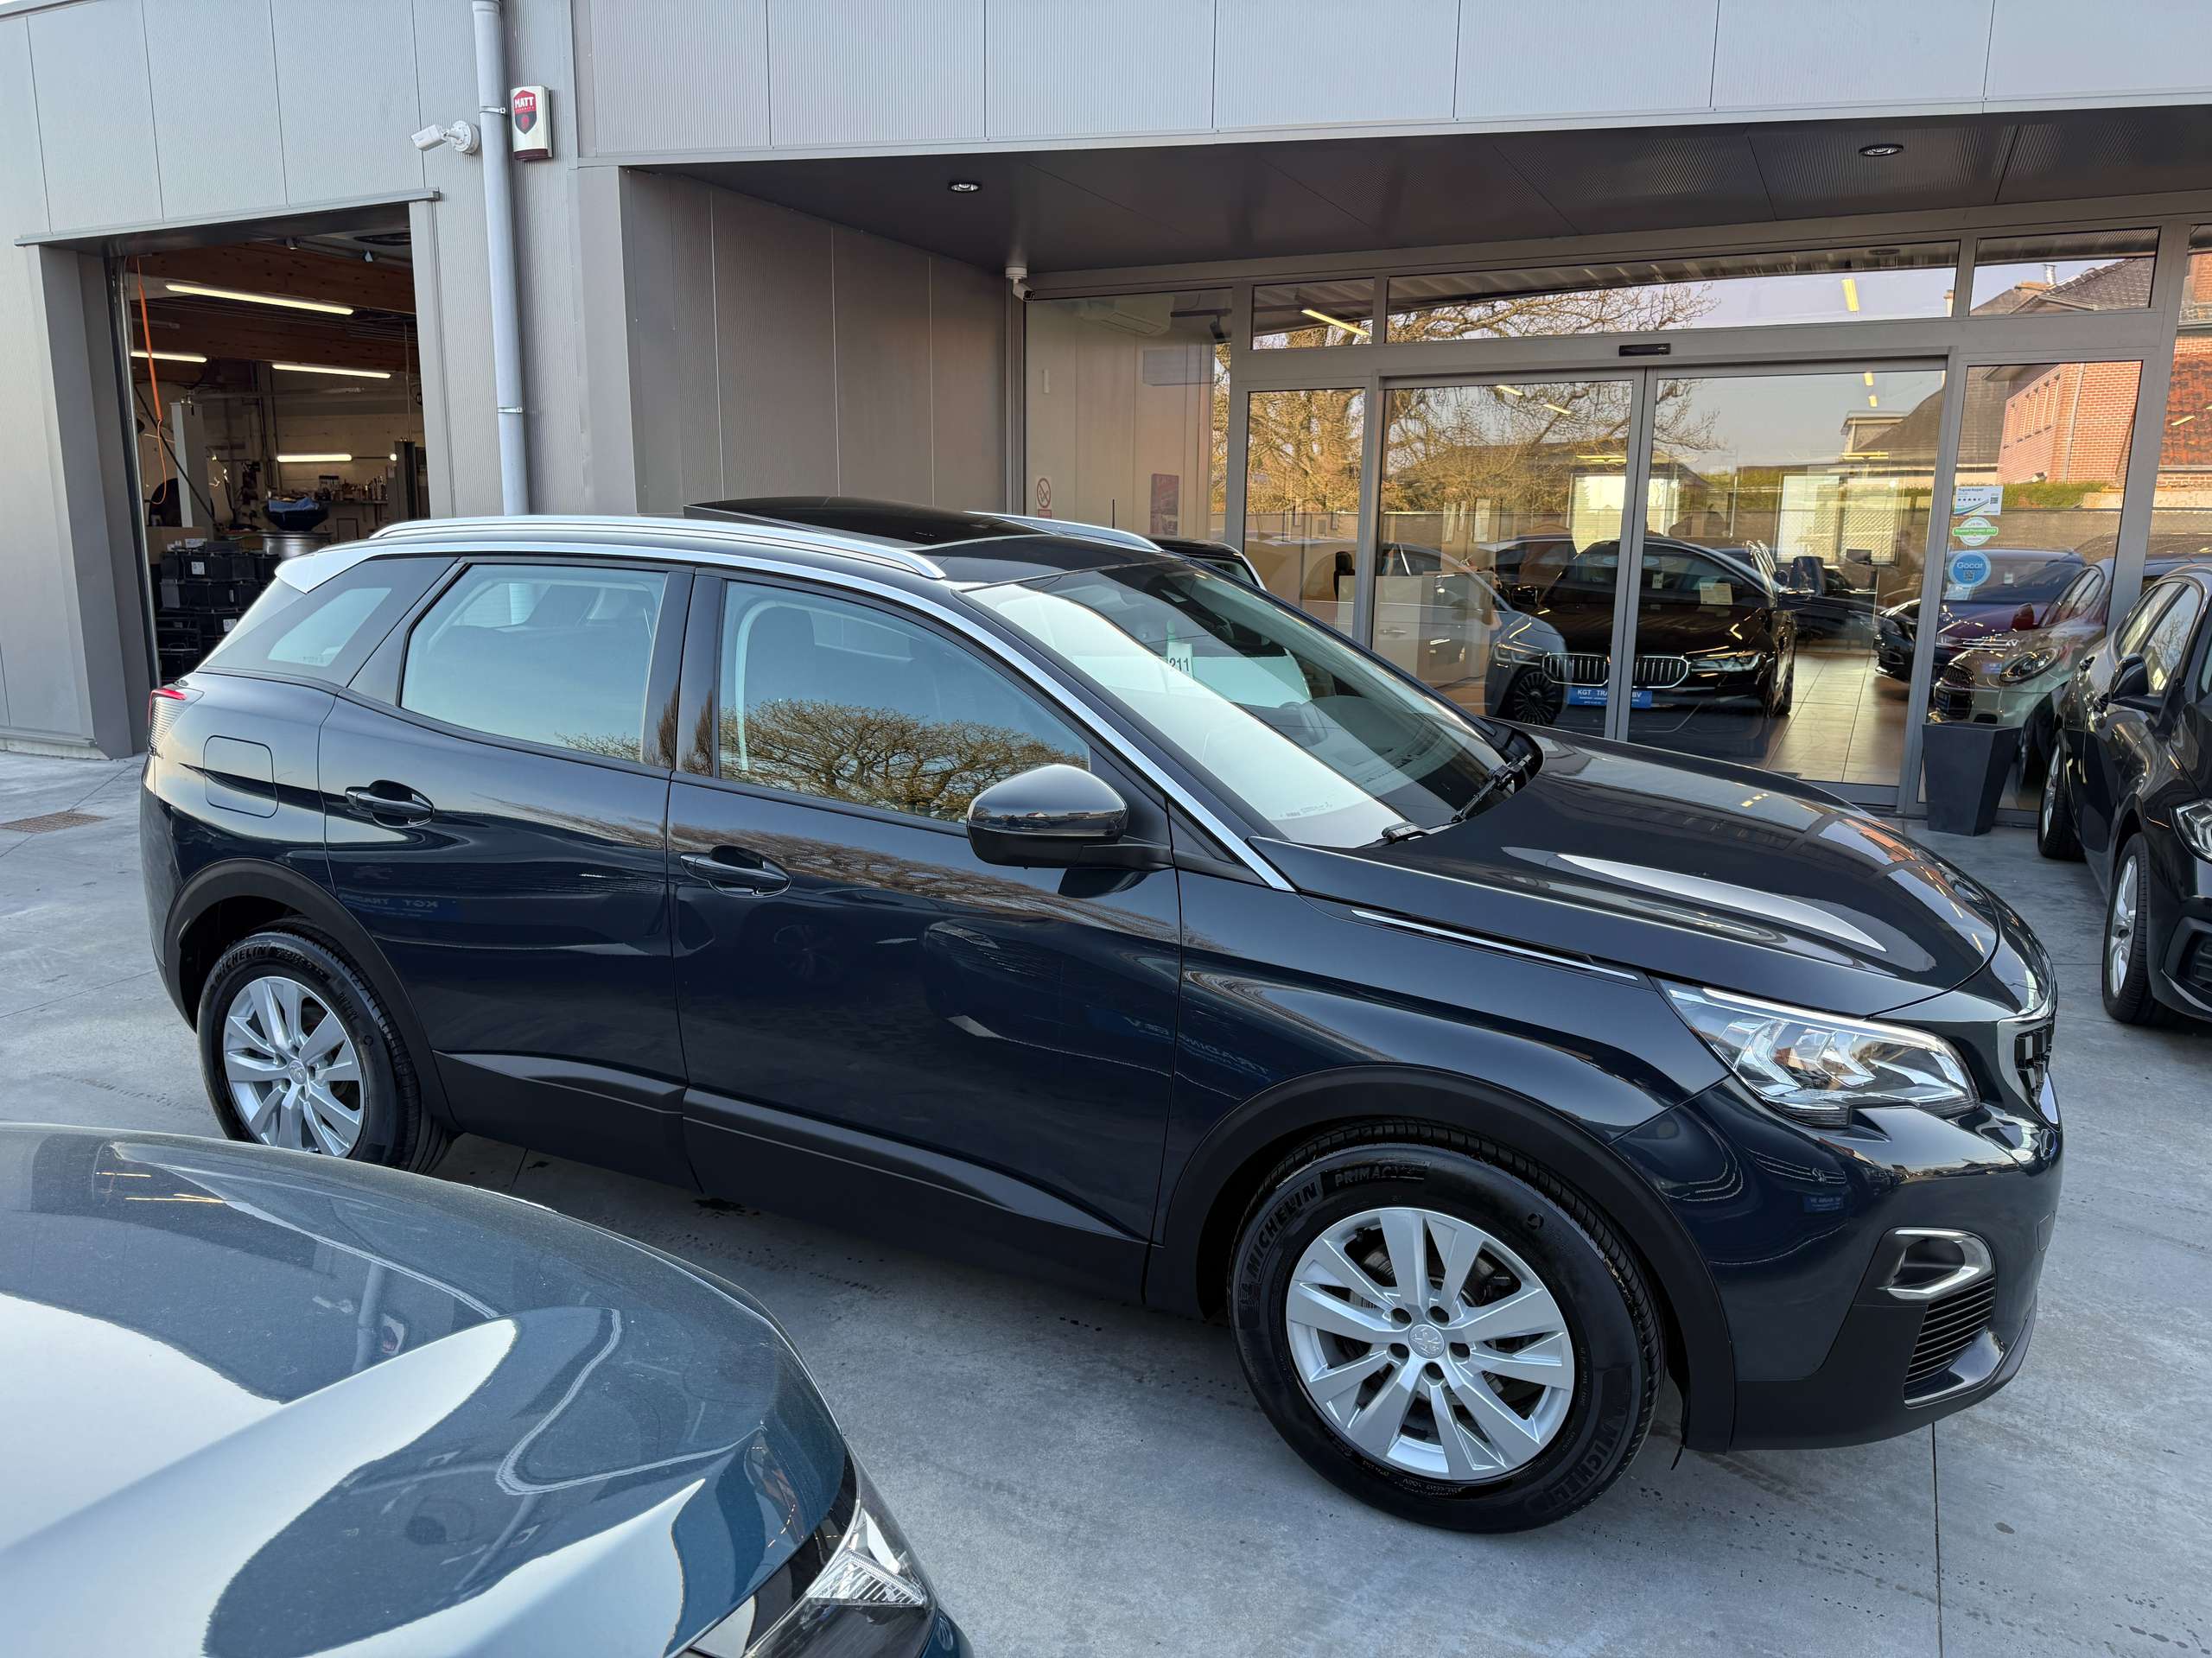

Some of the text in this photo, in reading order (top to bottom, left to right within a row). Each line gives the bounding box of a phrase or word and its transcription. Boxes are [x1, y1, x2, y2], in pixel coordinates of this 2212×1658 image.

[514, 97, 534, 108] MATT
[1169, 657, 1190, 672] 211
[216, 946, 265, 981] MICHELIN
[1246, 1182, 1318, 1275] MICHELIN
